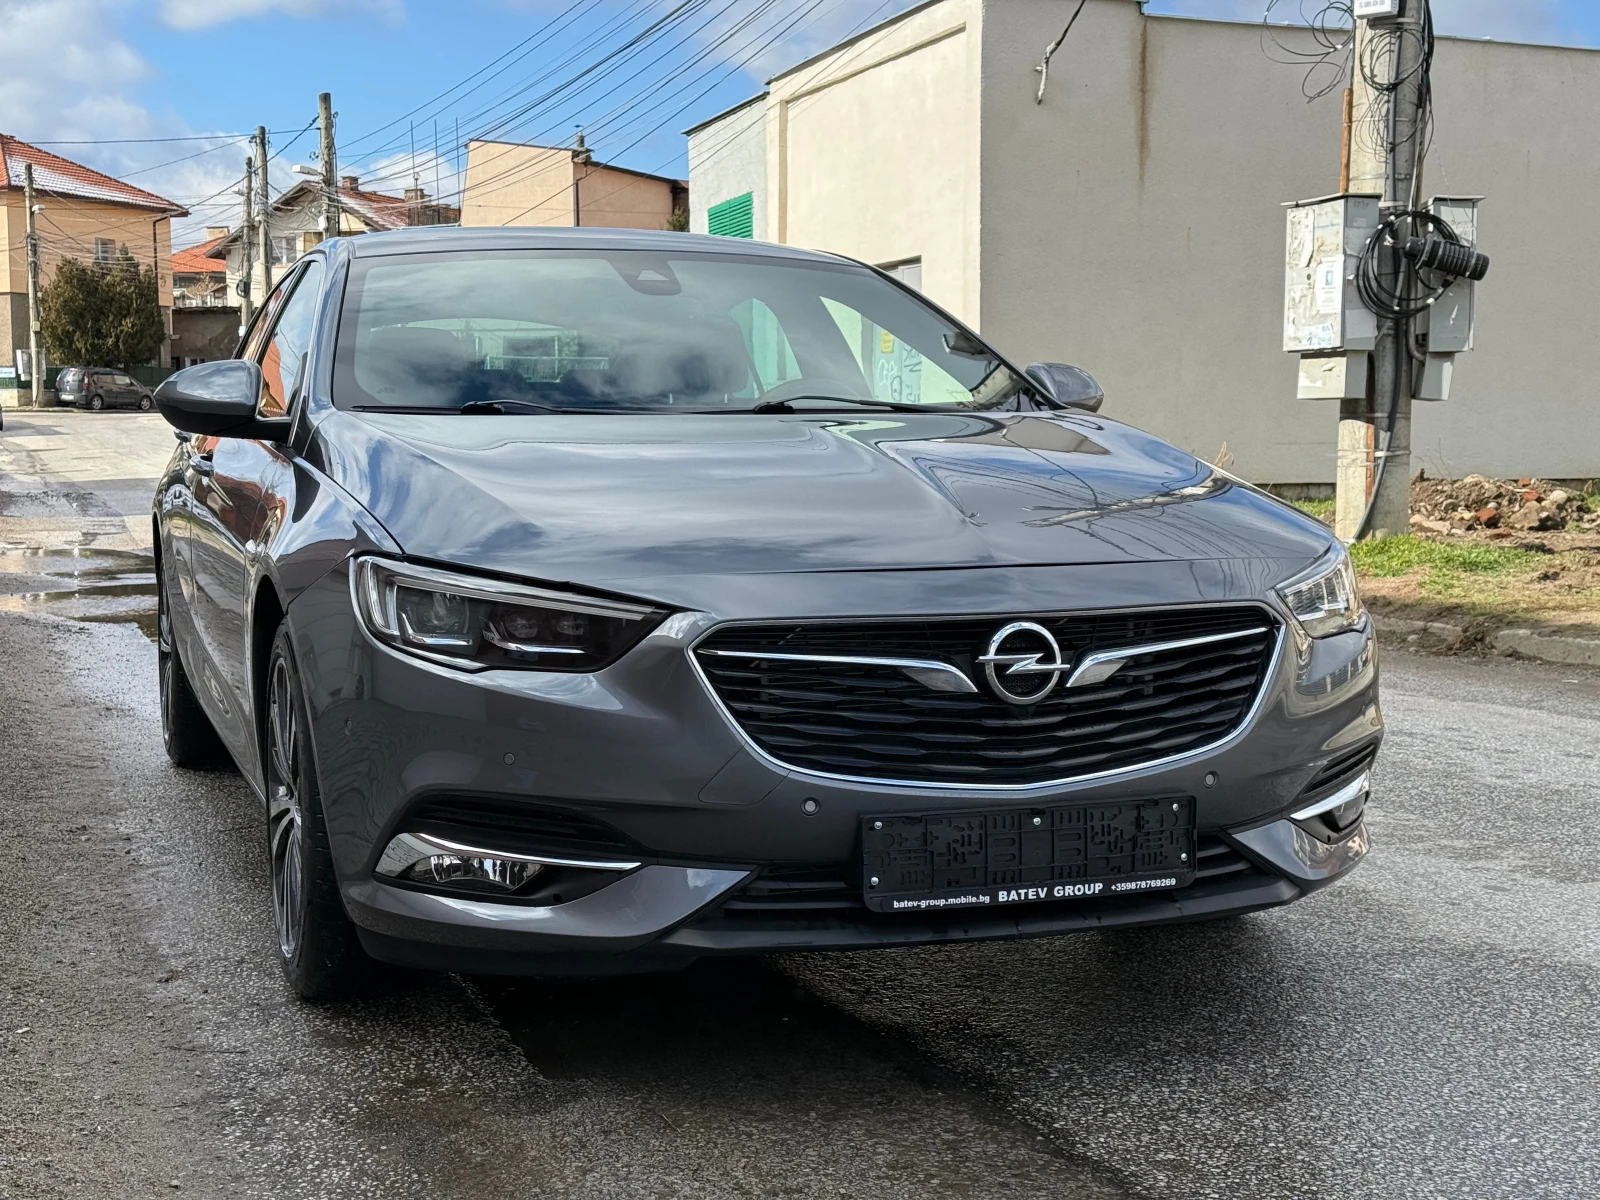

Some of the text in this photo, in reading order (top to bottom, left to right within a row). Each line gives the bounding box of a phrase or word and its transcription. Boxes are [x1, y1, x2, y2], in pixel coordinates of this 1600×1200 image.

[893, 877, 1177, 908] batev-group.mobile.bg BATEV GROUP +359878769269
